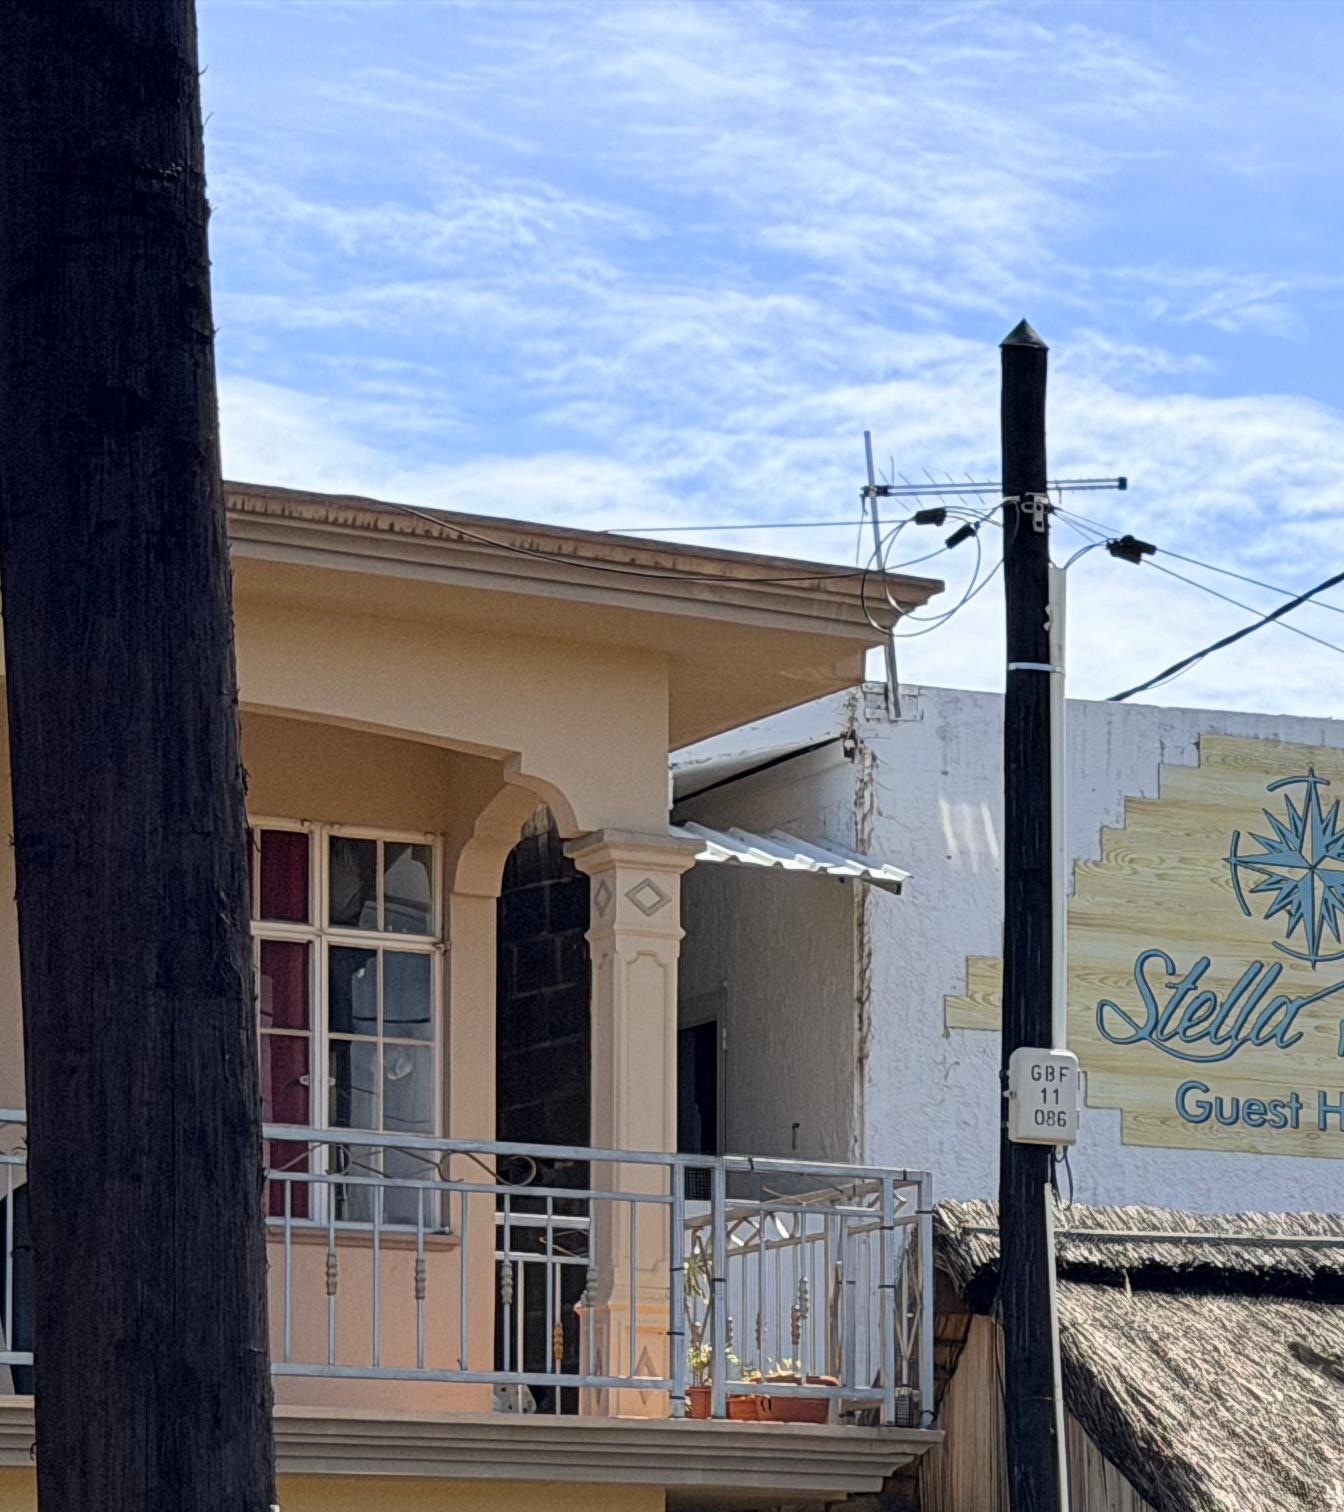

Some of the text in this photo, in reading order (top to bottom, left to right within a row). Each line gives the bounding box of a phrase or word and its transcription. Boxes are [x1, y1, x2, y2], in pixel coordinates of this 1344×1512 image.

[1096, 948, 1305, 1063] Stella
[1031, 1064, 1070, 1083] GBF
[1040, 1087, 1059, 1105] 11
[1175, 1079, 1302, 1130] Guest
[1034, 1109, 1067, 1128] 086
